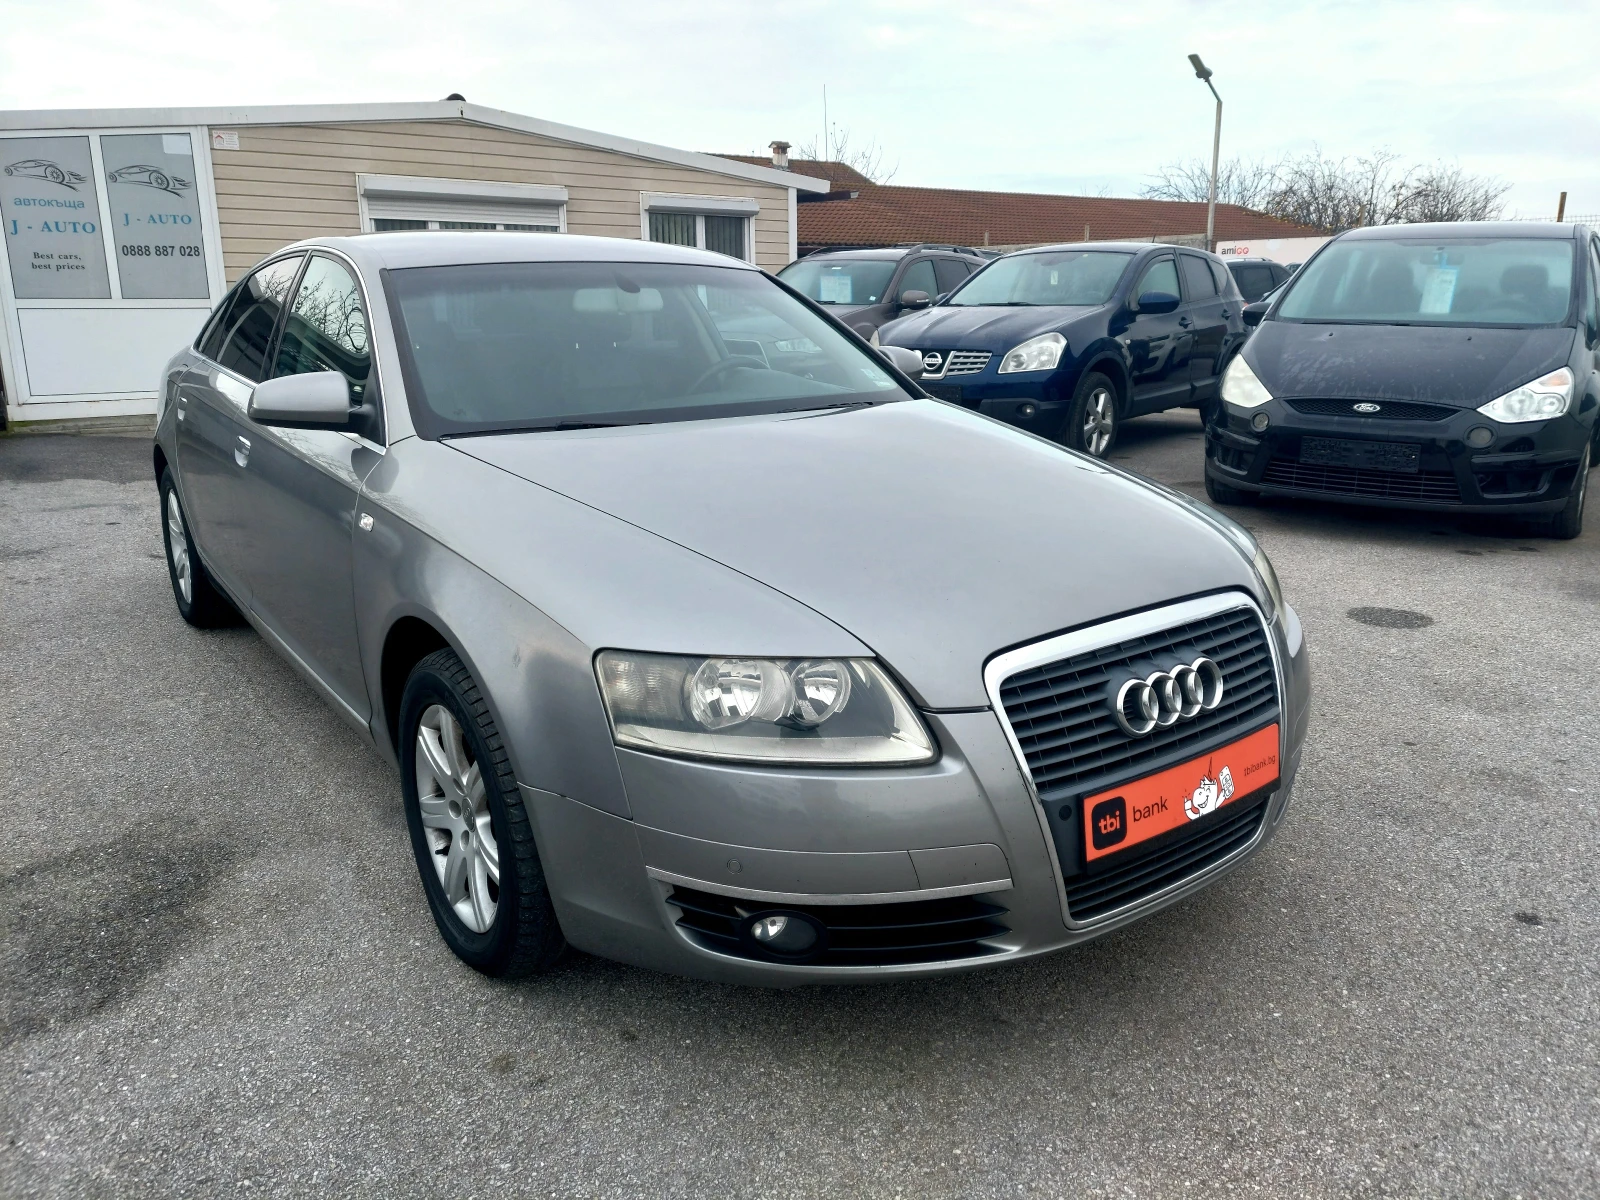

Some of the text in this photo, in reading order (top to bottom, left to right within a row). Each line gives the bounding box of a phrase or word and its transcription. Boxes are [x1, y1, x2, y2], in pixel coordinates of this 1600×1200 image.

[13, 197, 86, 210] автокъща
[123, 212, 130, 227] J
[147, 214, 192, 225] AUTO
[10, 219, 18, 236] J
[41, 220, 96, 234] AUTO
[33, 251, 82, 261] Best cars,
[122, 244, 200, 257] 0888 887 028
[31, 262, 86, 272] best prices
[1243, 755, 1276, 777] tbibank.bg
[1098, 796, 1168, 834] tbi bank
